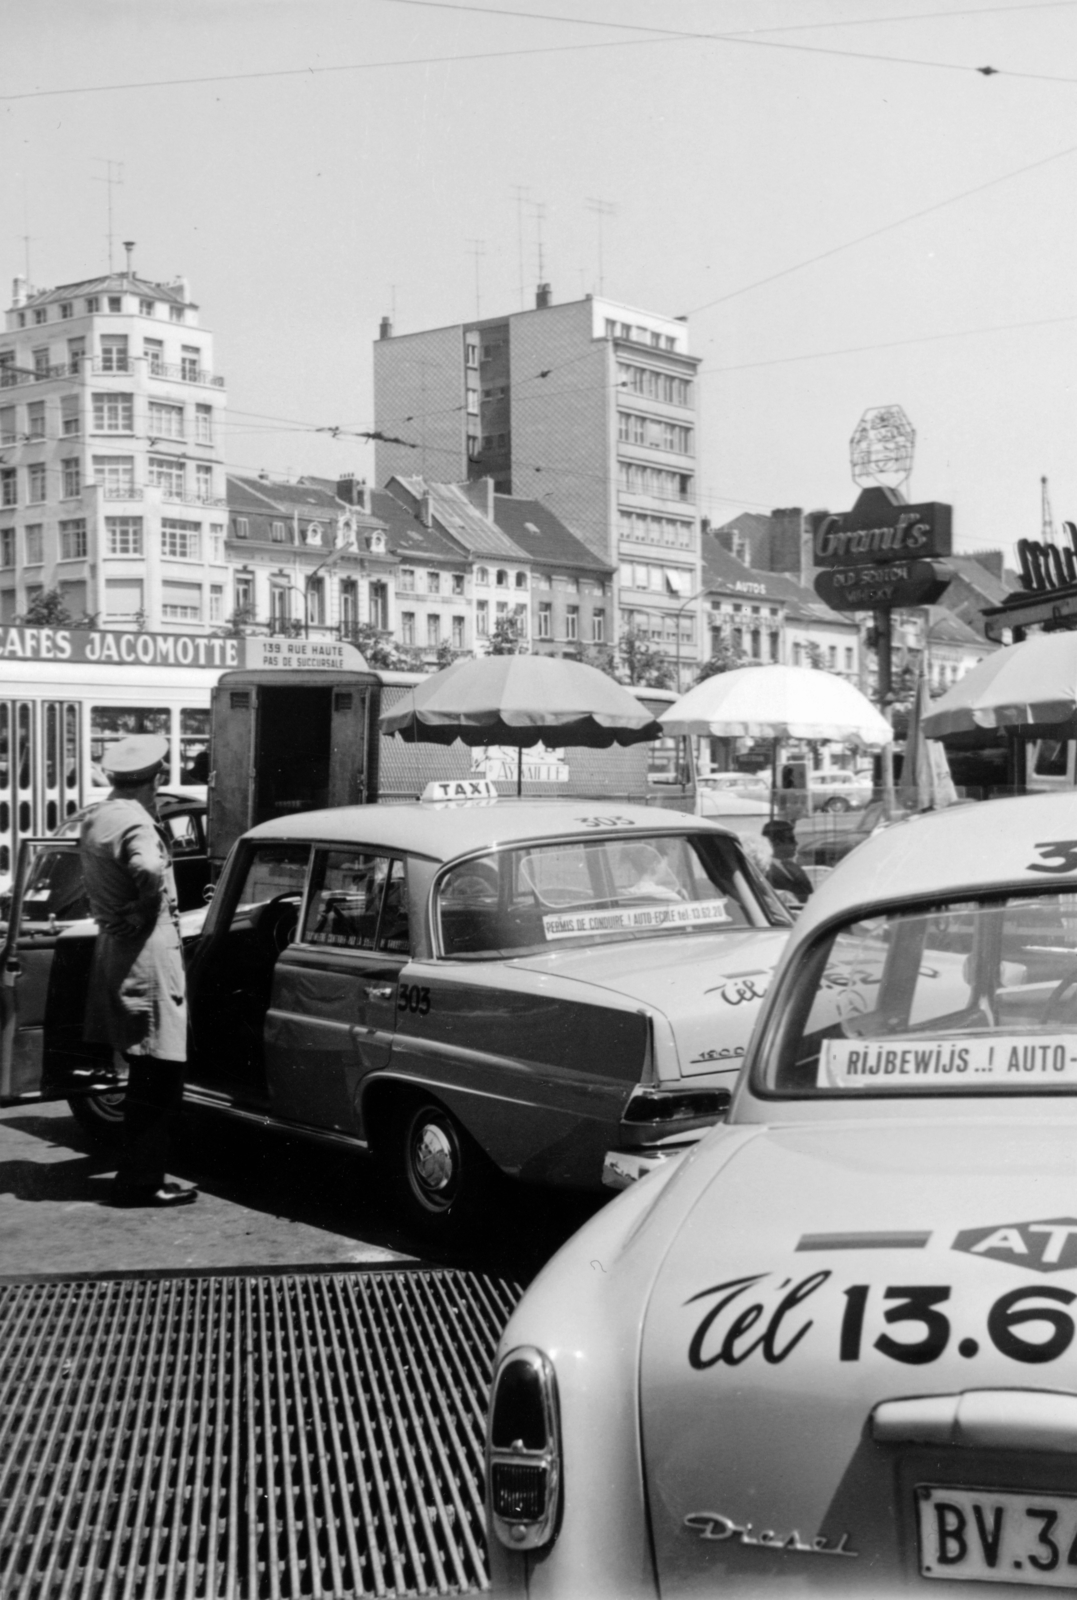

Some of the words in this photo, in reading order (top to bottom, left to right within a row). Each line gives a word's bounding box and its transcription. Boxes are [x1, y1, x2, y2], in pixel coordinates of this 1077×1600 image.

[85, 632, 239, 666] JACQMOTTE
[288, 644, 308, 655] RUE
[312, 646, 344, 657] HAUTE
[263, 656, 279, 667] PAS
[282, 656, 292, 668] DE
[297, 657, 344, 669] SUCCURSALE
[439, 782, 491, 797] TAXI
[573, 815, 635, 828] 303
[545, 918, 575, 934] PERMIS
[577, 918, 587, 931] DE
[397, 983, 431, 1016] 303
[1006, 1044, 1077, 1073] AUTO-
[681, 1269, 833, 1371] Tél
[840, 1284, 1076, 1366] 13.6
[683, 1511, 858, 1557] Diesel
